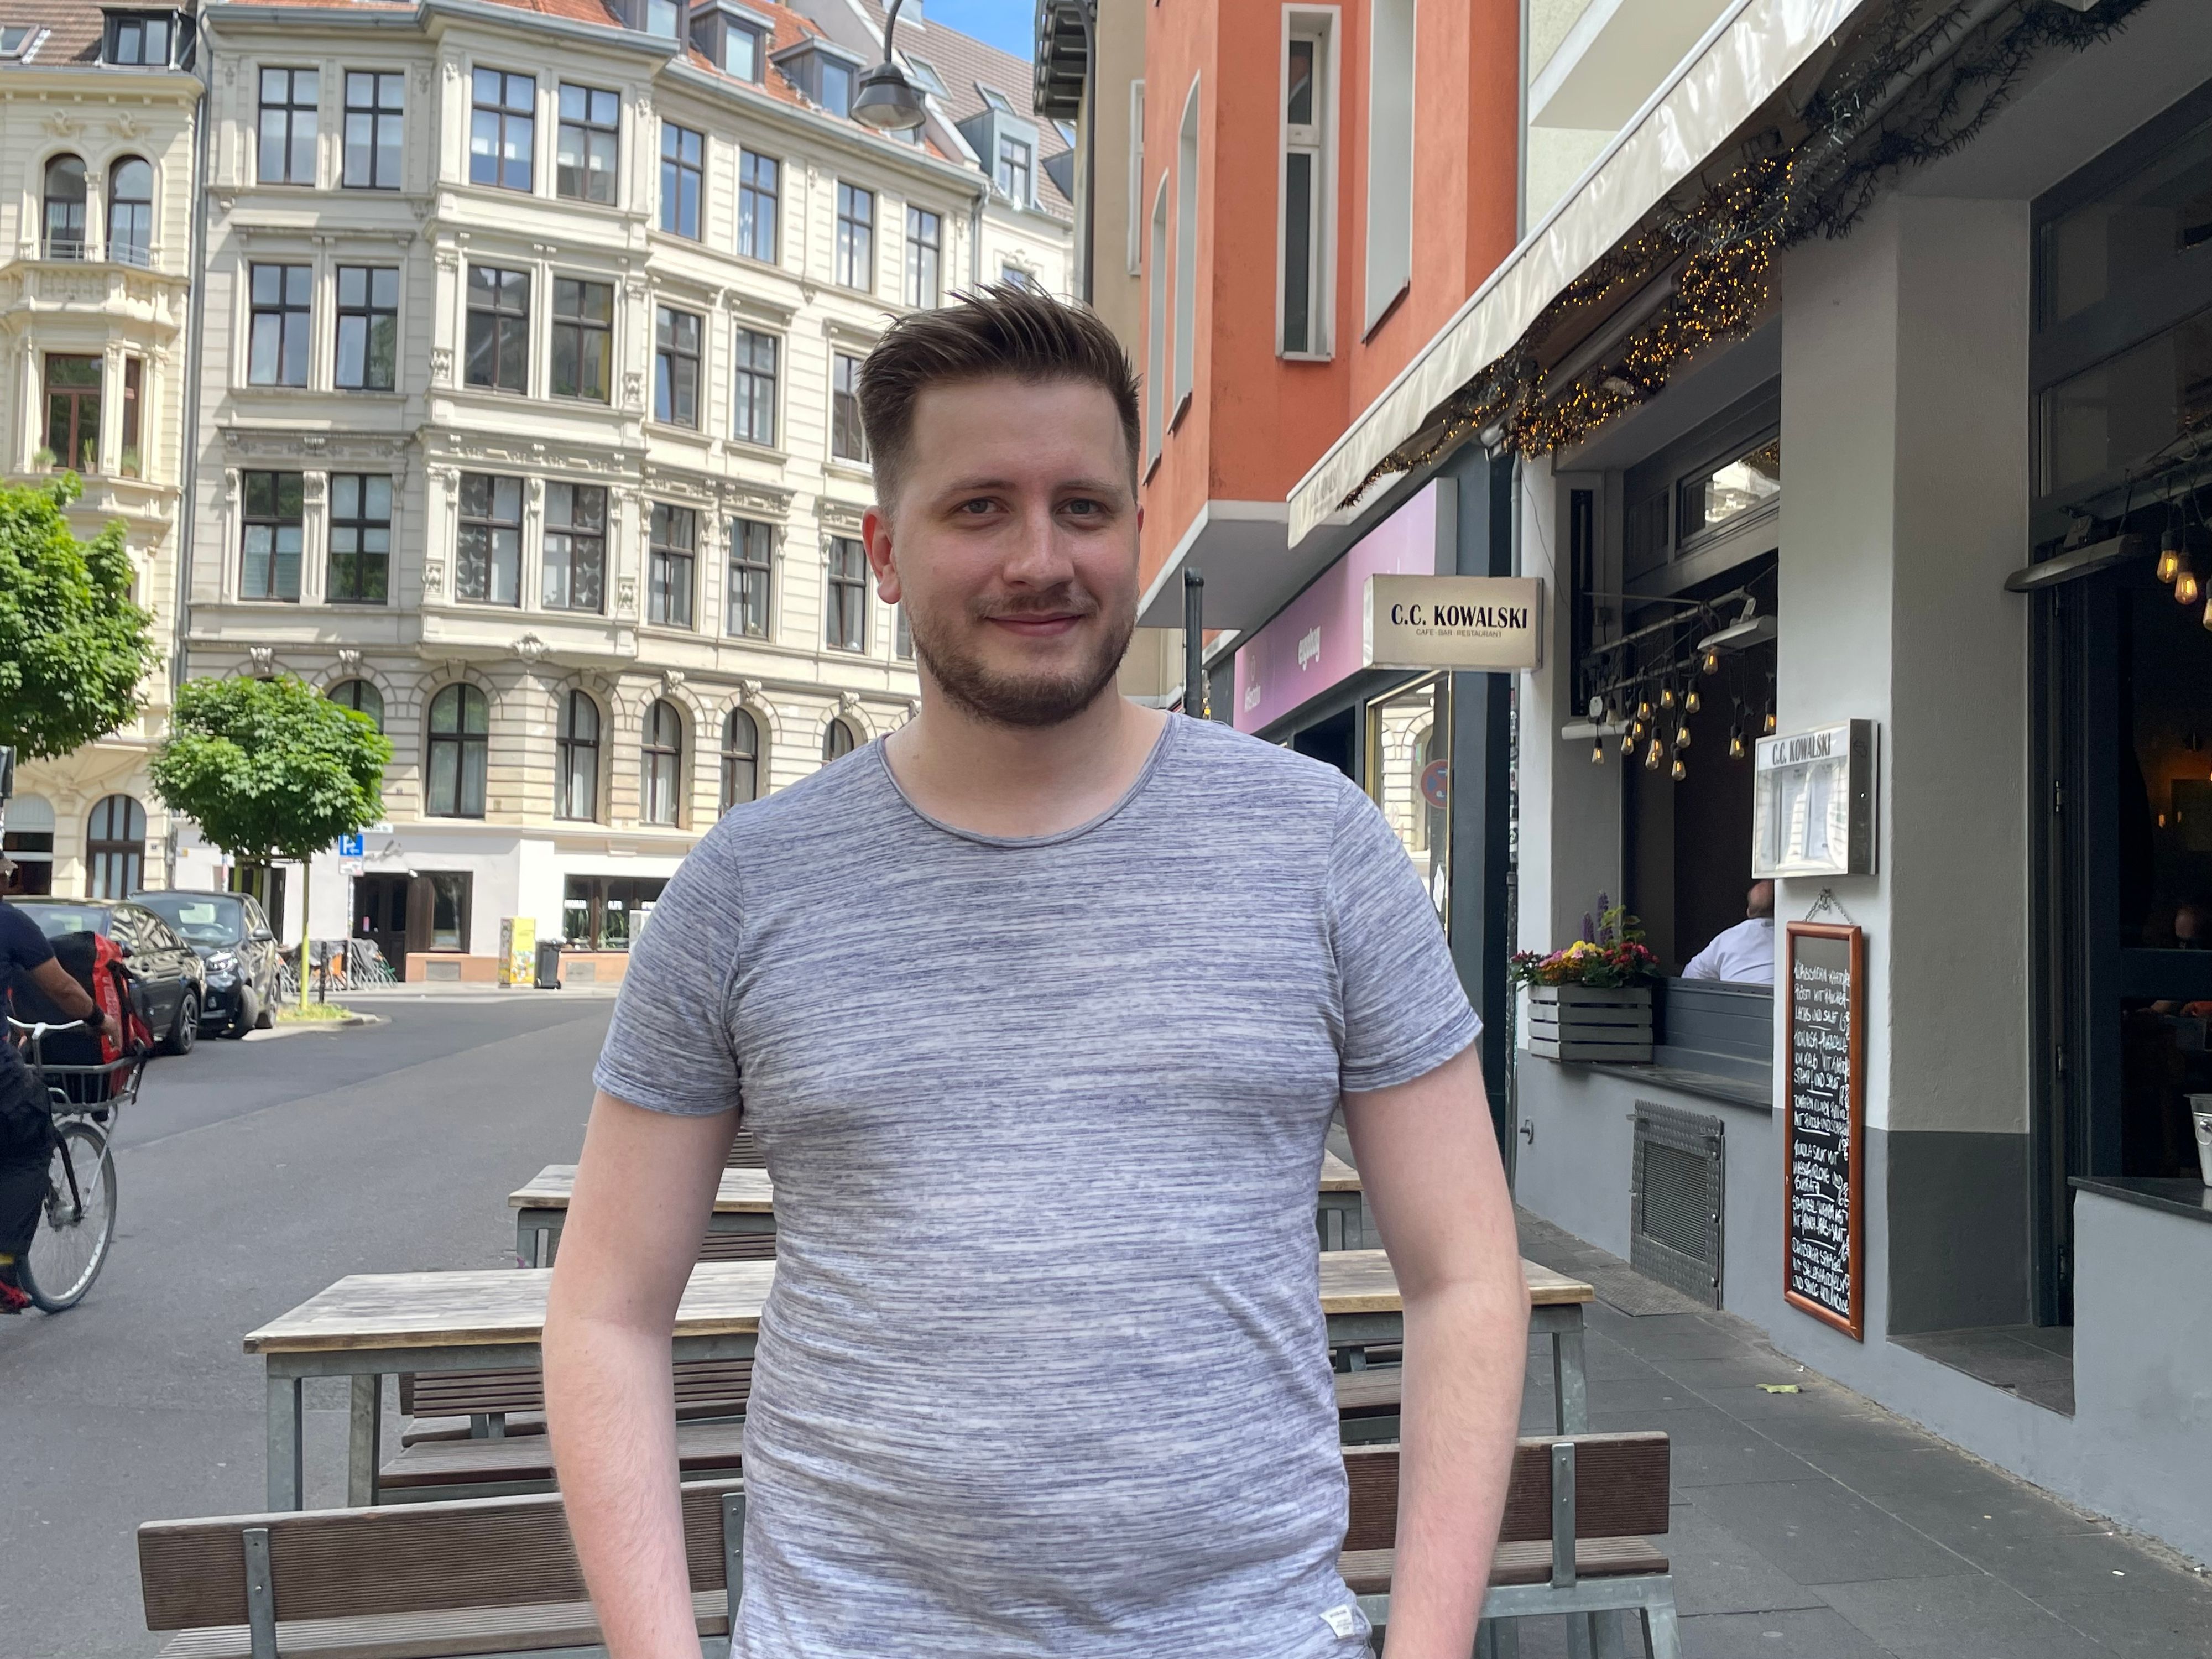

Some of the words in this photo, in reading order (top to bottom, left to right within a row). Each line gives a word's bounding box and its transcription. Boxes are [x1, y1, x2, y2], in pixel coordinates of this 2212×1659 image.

[1391, 603, 1426, 625] C.C.
[1434, 605, 1527, 629] KOWALSKI
[1772, 742, 1787, 765] C.C.
[1789, 732, 1831, 762] KOWALSKI
